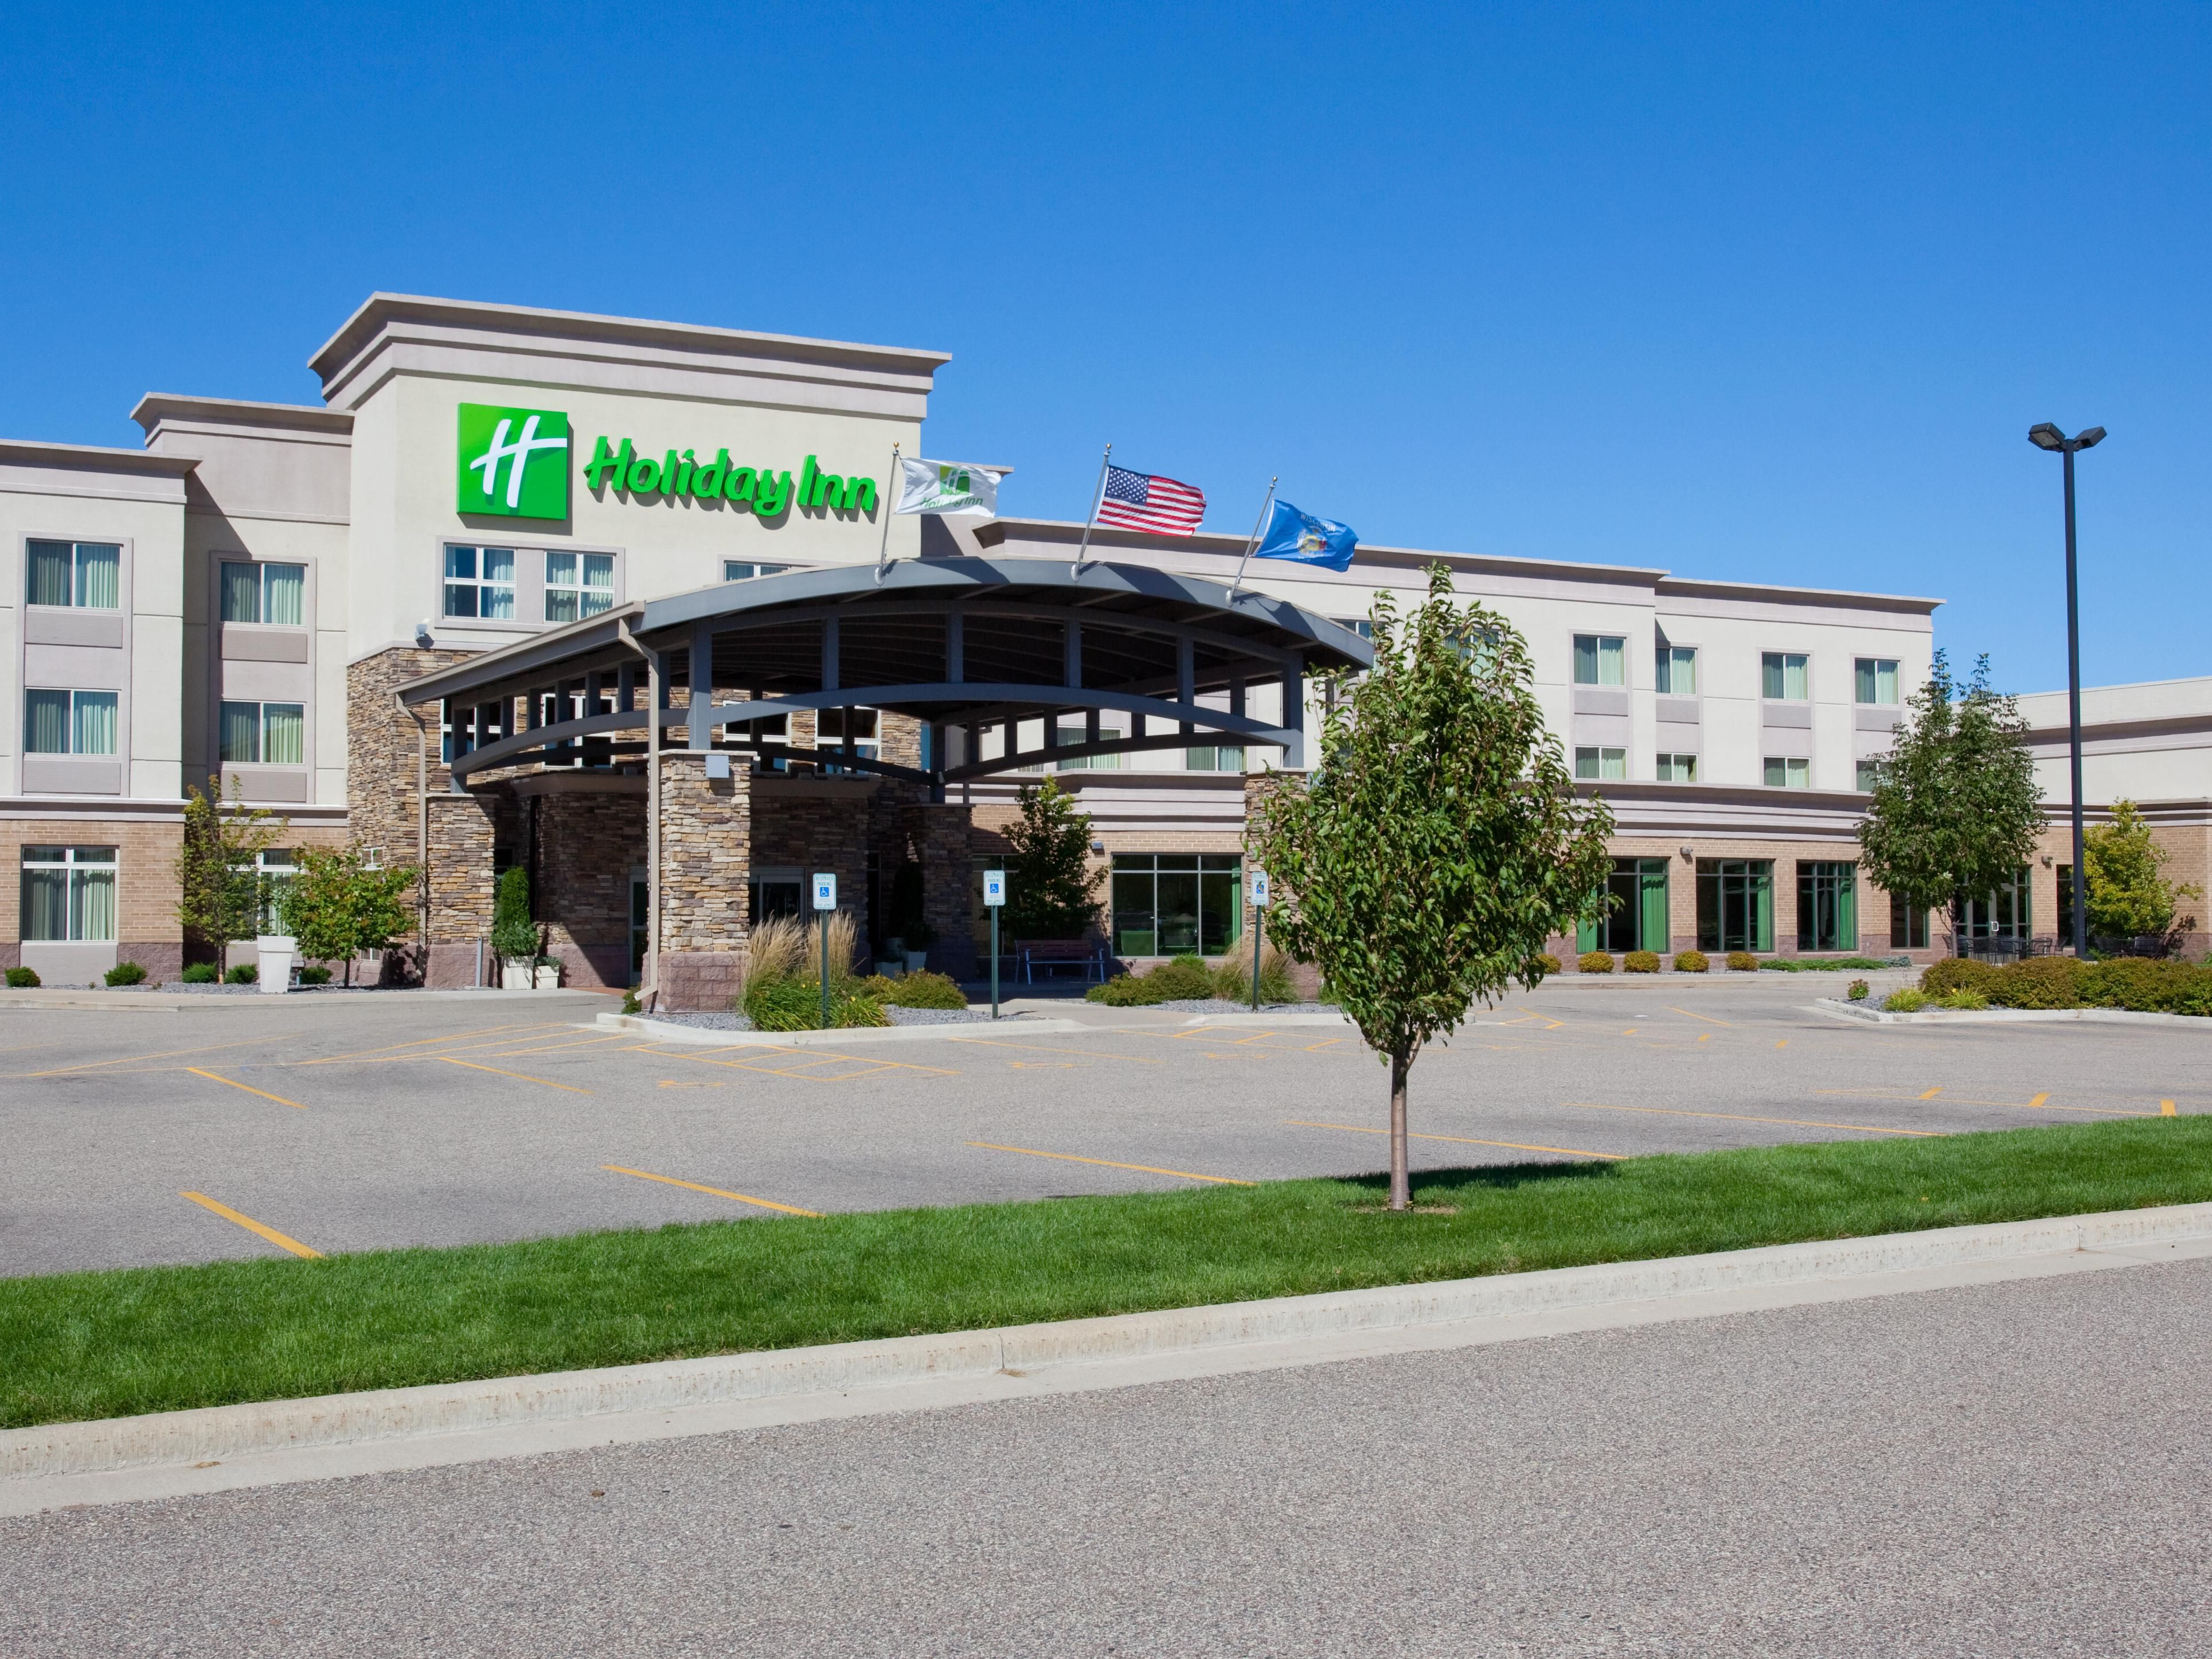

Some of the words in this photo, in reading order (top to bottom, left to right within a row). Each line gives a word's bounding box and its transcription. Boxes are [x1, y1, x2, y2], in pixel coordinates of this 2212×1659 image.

[470, 416, 567, 508] H
[584, 436, 791, 517] Holiday
[796, 455, 876, 512] Inn
[920, 497, 964, 509] Holiy
[964, 497, 983, 506] Inn
